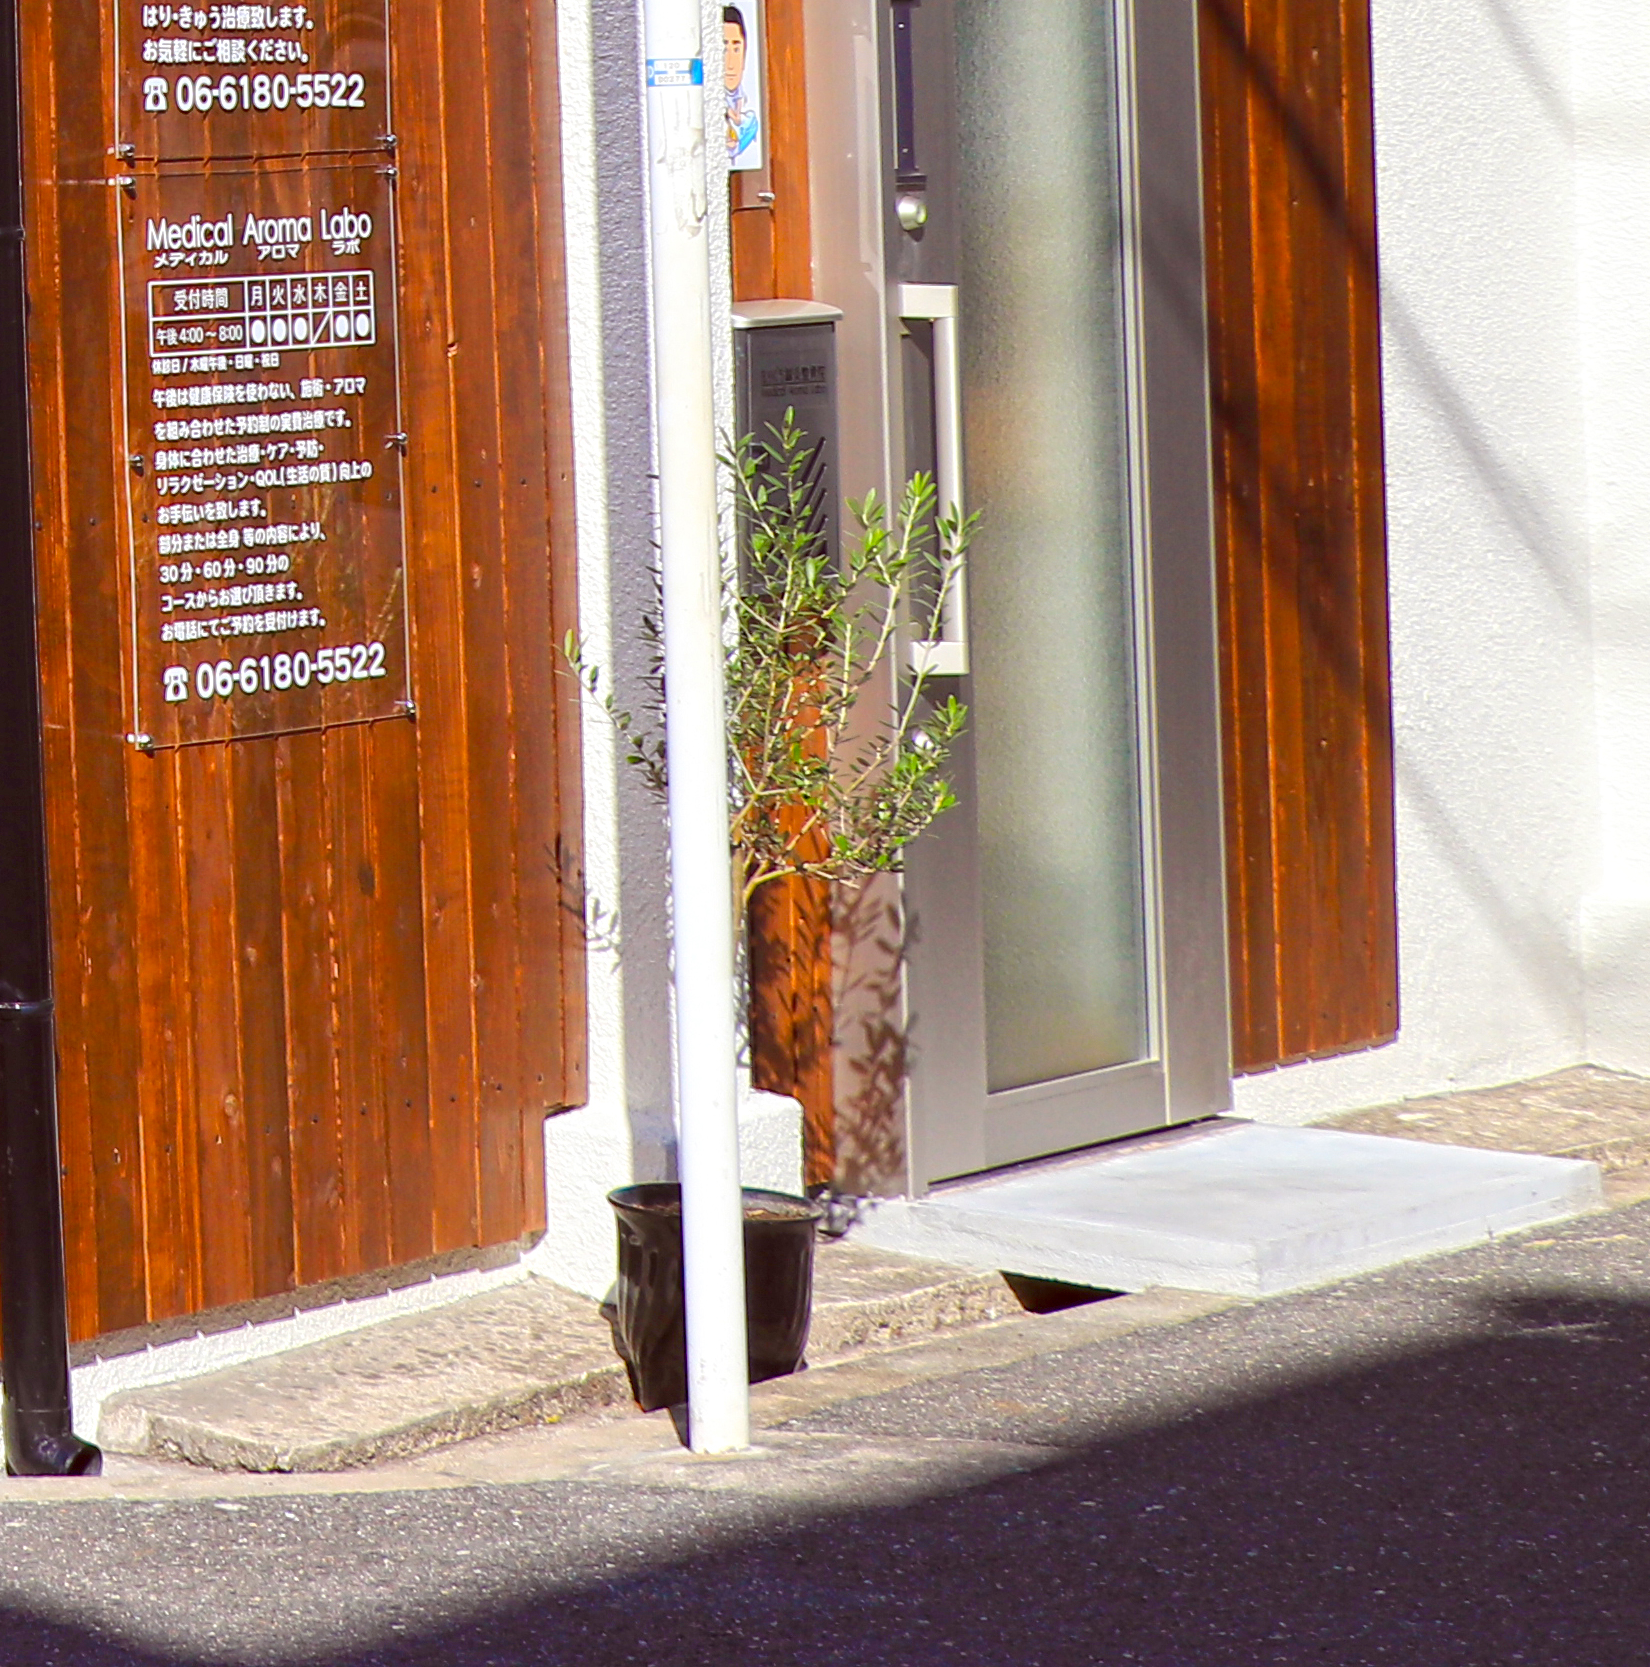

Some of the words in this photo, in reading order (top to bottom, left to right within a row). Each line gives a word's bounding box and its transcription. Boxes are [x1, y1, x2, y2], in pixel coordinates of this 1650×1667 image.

[143, 4, 314, 30] はり・きゅう治療致します。
[143, 38, 309, 64] お気軽にご相談ください。
[175, 73, 366, 112] 06-6180-5522
[147, 213, 234, 251] Medical
[242, 213, 312, 246] Aroma
[320, 206, 373, 241] Labo
[153, 249, 229, 269] メディカル
[257, 243, 301, 261] アロマ
[332, 238, 361, 256] ラボ
[173, 287, 229, 311] 受付時間
[250, 285, 263, 307] 月
[271, 284, 286, 306] 火
[293, 283, 307, 304] 水
[313, 282, 327, 302] 木
[334, 282, 348, 302] 金
[355, 280, 368, 301] 土
[157, 498, 267, 525] お手伝いを致します。
[161, 582, 304, 612] コースからお選び頂きます。
[161, 607, 327, 641] お電話にてご予約を受付けます。
[196, 641, 387, 699] 06-6180-5522
